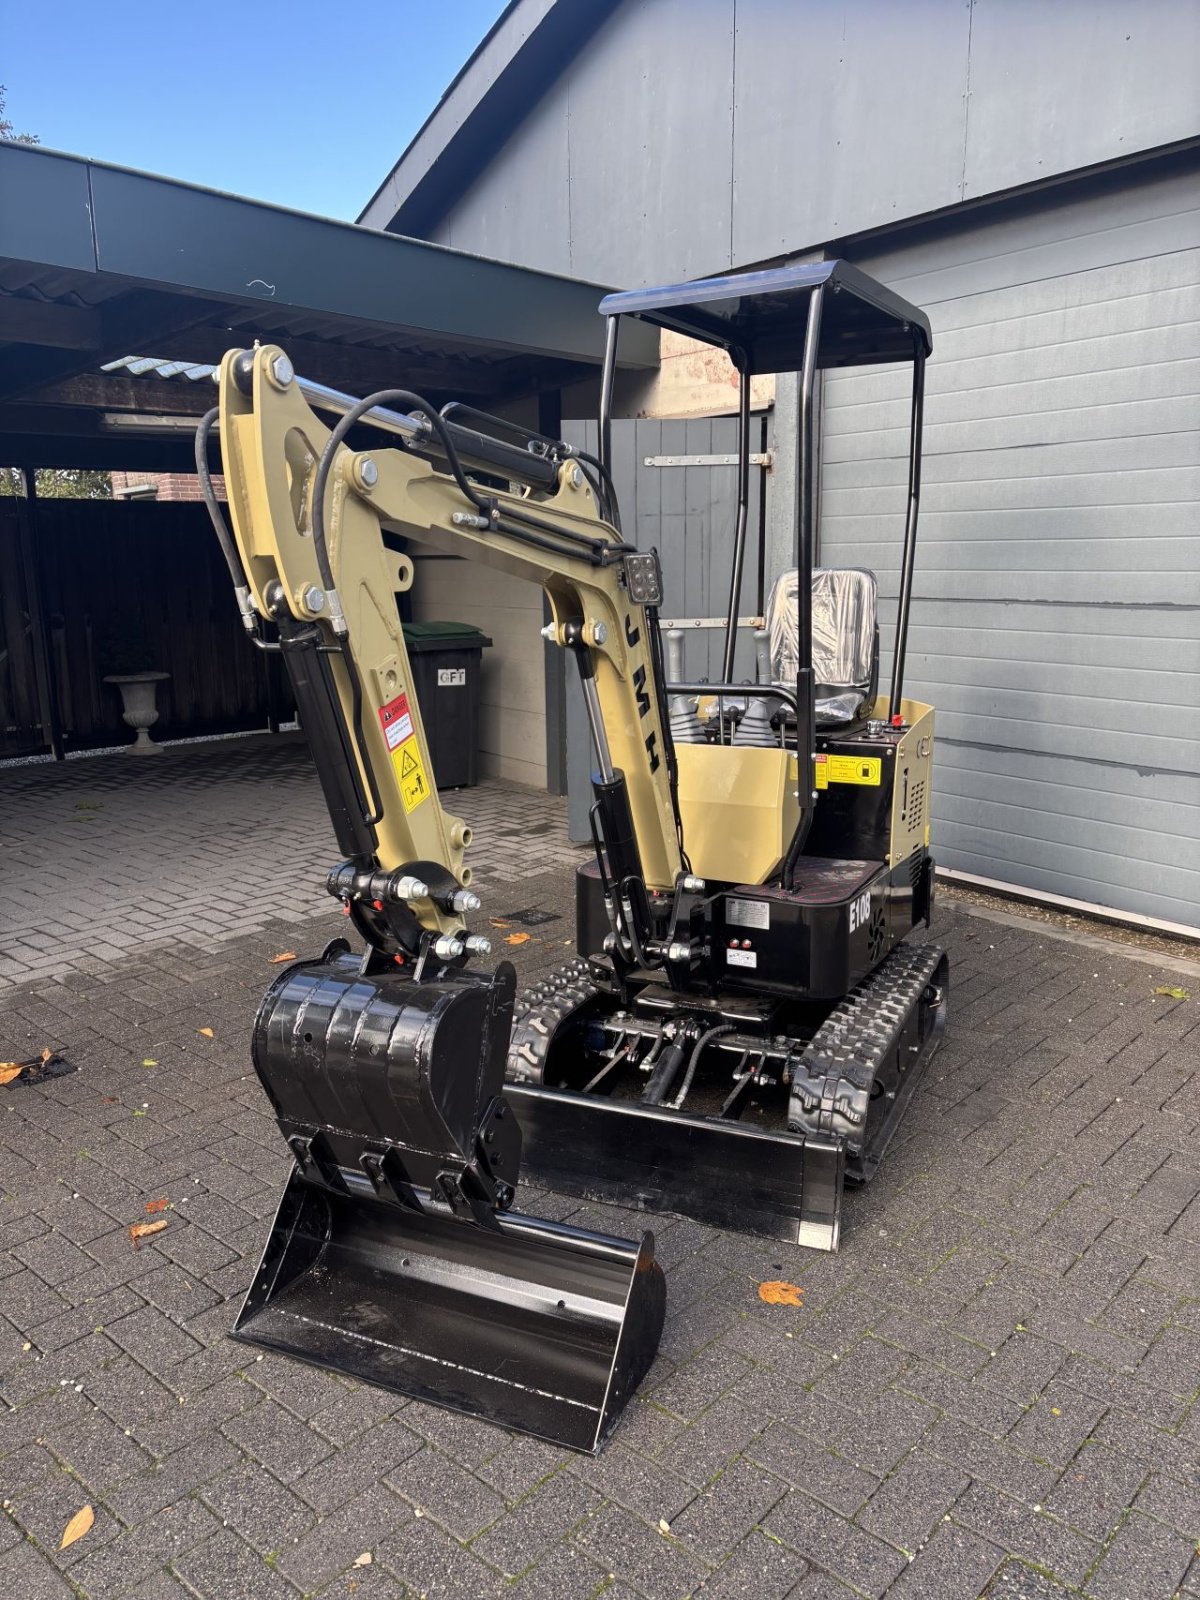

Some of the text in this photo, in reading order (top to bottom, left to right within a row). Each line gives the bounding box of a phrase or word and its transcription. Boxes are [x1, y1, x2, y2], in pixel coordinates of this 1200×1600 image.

[440, 672, 464, 683] GFT
[624, 614, 660, 775] JMH
[849, 891, 871, 934] E108
